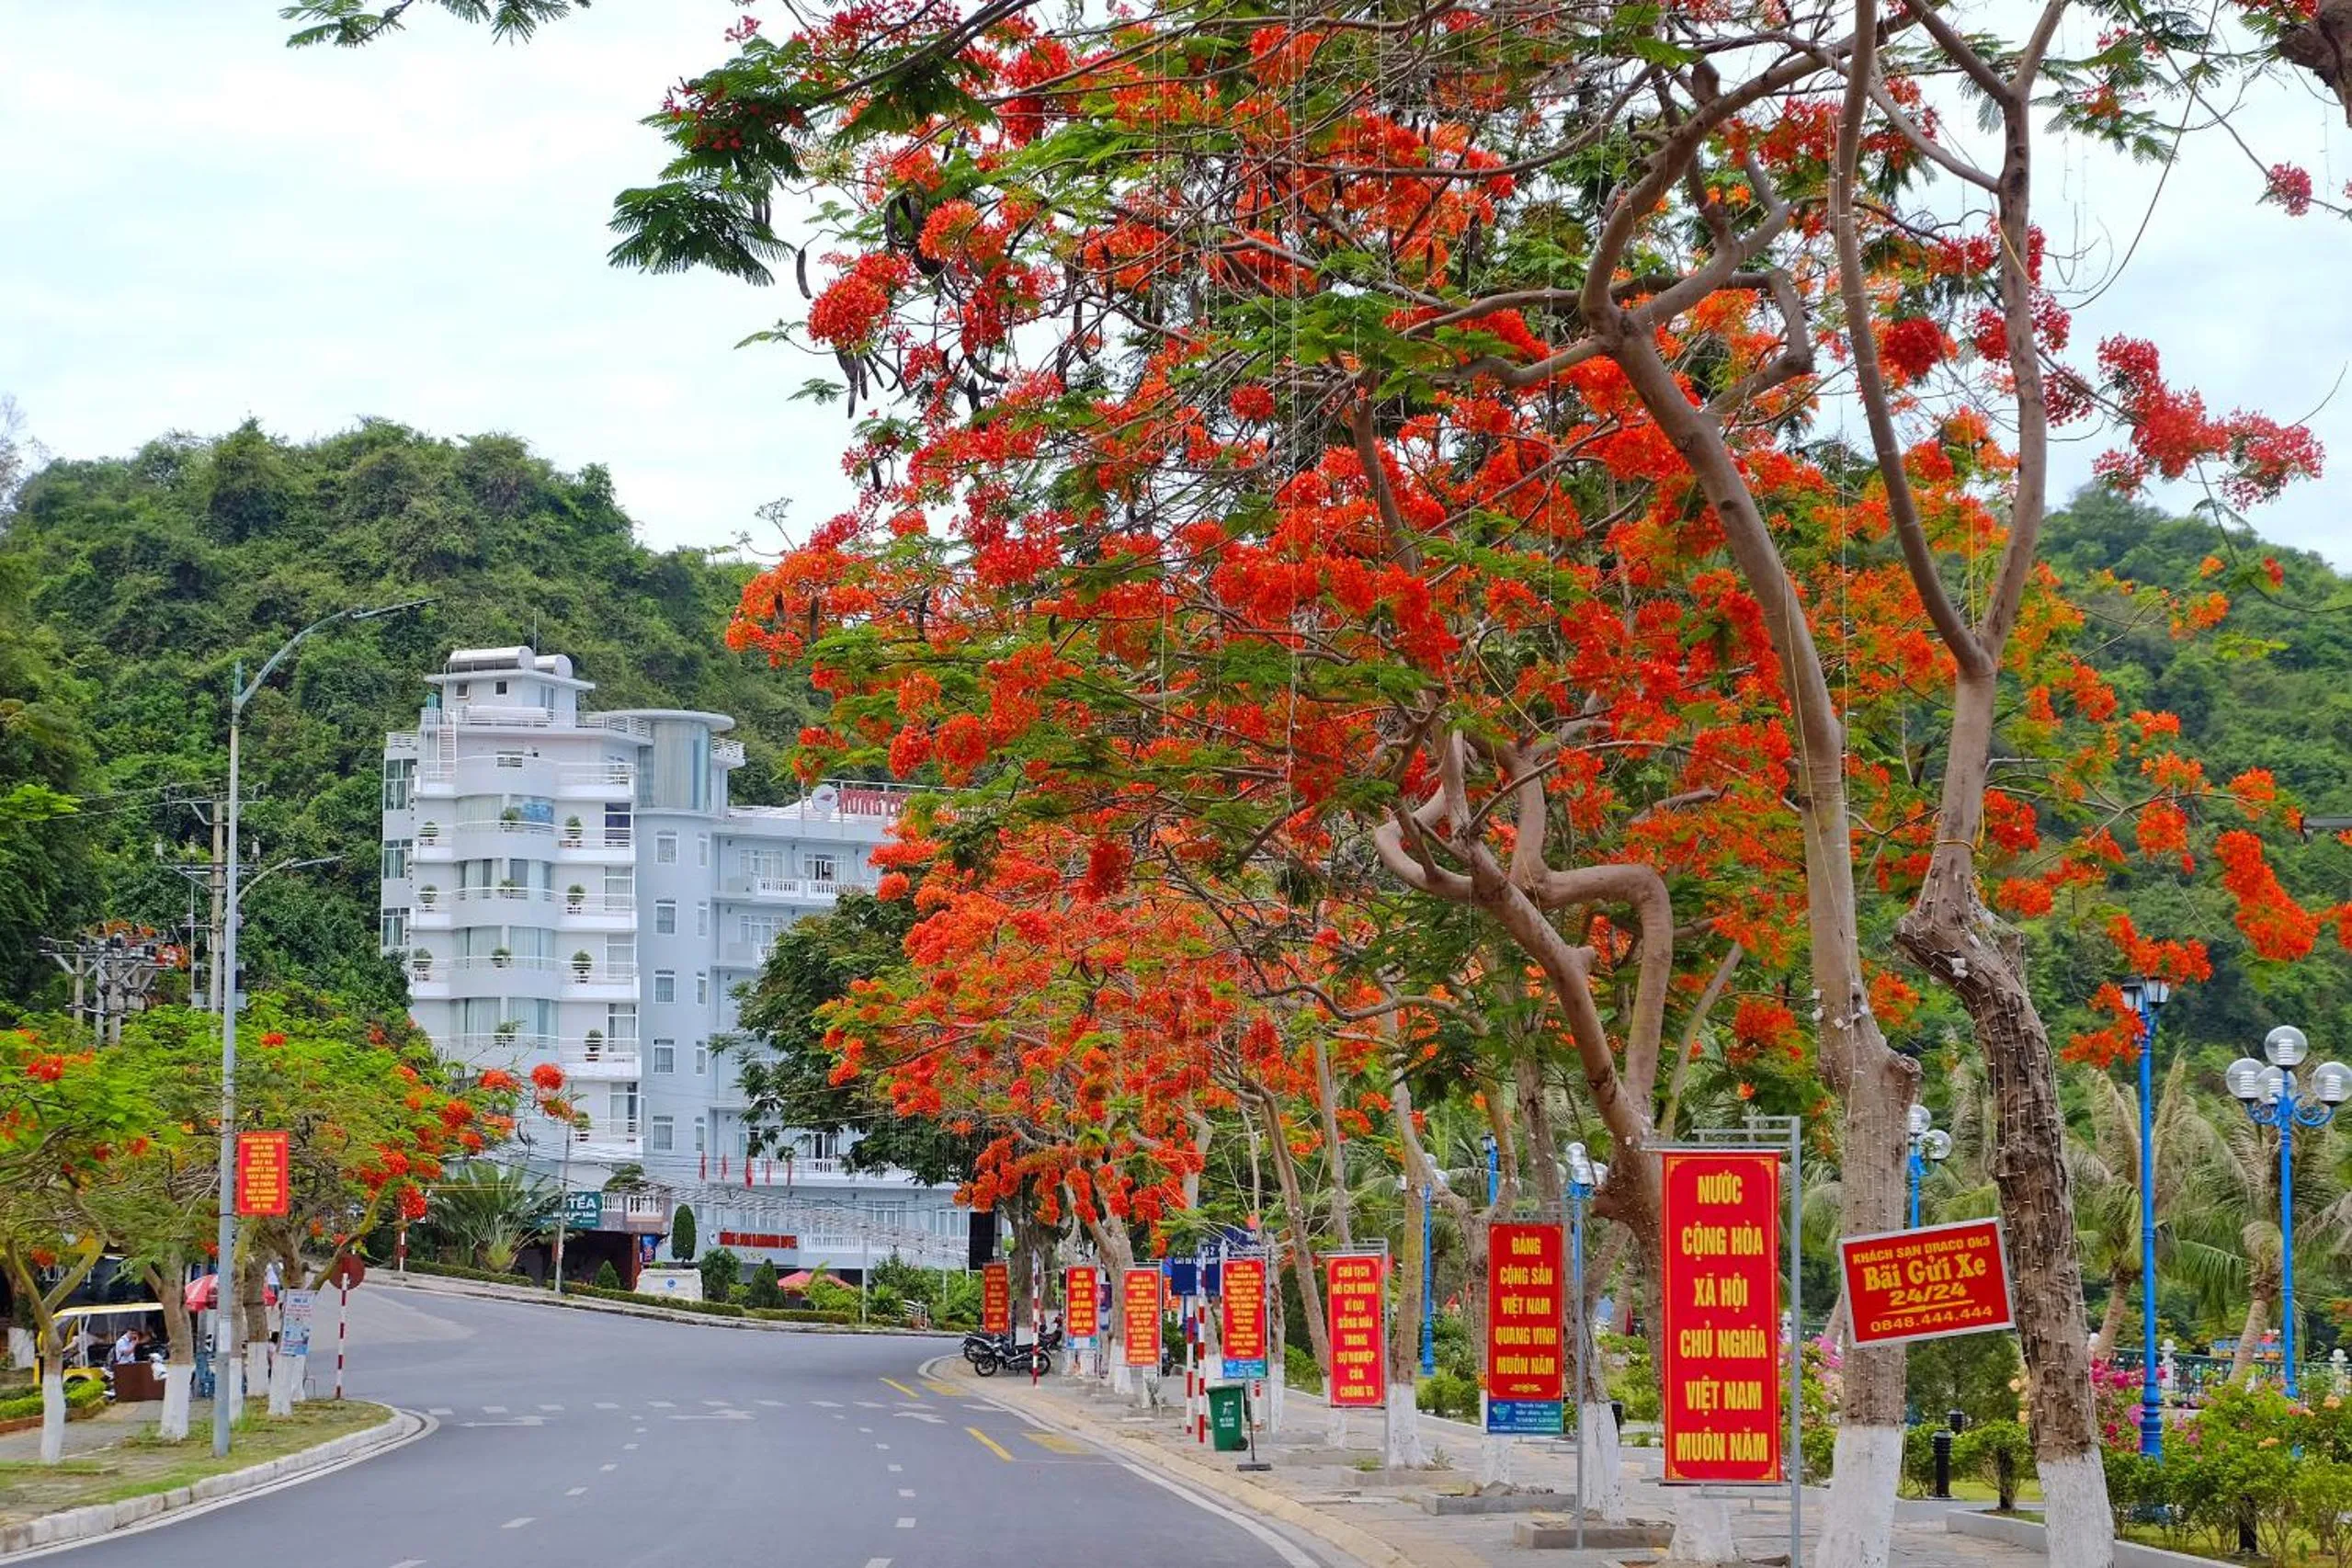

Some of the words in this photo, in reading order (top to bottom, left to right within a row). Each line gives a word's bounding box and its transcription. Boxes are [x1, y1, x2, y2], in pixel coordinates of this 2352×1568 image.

[1698, 1169, 1743, 1205] NƯỚC
[1682, 1221, 1727, 1262] CỘNG
[1731, 1220, 1764, 1256] HÒA
[1853, 1247, 1893, 1265] KHÁCH
[1500, 1263, 1529, 1289] CỘNG
[1531, 1261, 1553, 1285] SẢN
[1863, 1263, 1903, 1291] Bãi
[1907, 1256, 1952, 1285] Gửi
[1954, 1253, 1986, 1278] Xe
[1500, 1293, 1524, 1320] VIỆT
[1527, 1297, 1551, 1314] NAM
[1693, 1272, 1717, 1307] XÃ
[1721, 1272, 1748, 1313] HỘI
[1889, 1283, 1968, 1306] 24/24
[1869, 1306, 1994, 1333] 0848.444.444
[1495, 1326, 1530, 1346] QUANG
[1532, 1327, 1557, 1345] VINH
[1680, 1320, 1713, 1358] CHỦ
[1718, 1324, 1767, 1358] NGHĨA
[1496, 1353, 1528, 1375] MUÔN
[1530, 1354, 1555, 1375] NĂM
[1685, 1375, 1720, 1416] VIỆT
[1723, 1381, 1763, 1411] NAM
[1676, 1426, 1725, 1462] MUÔN
[1729, 1426, 1768, 1462] NĂM
